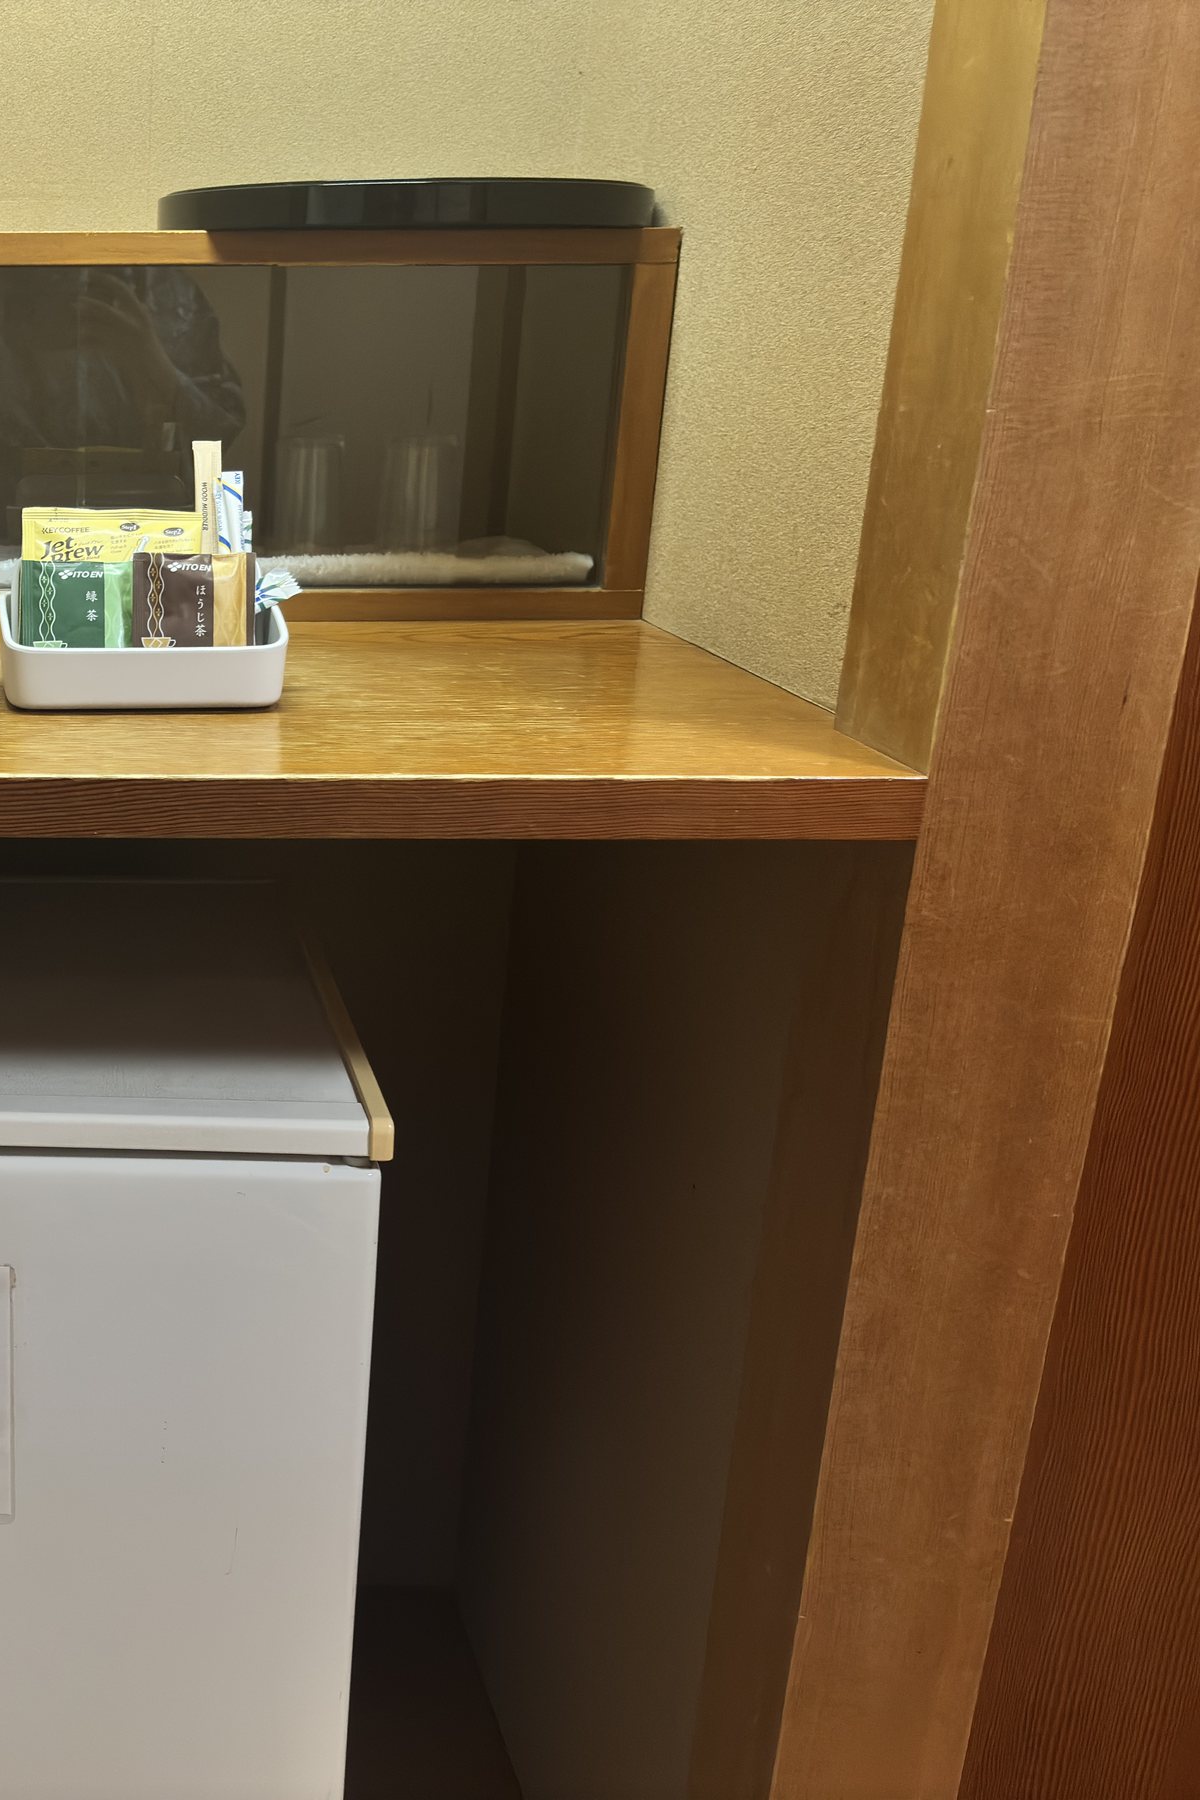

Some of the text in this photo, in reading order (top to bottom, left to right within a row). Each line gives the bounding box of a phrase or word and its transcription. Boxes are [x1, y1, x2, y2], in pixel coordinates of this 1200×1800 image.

[41, 536, 74, 560] Jet
[85, 590, 98, 622] 緑茶
[194, 585, 207, 637] ほうじ茶
